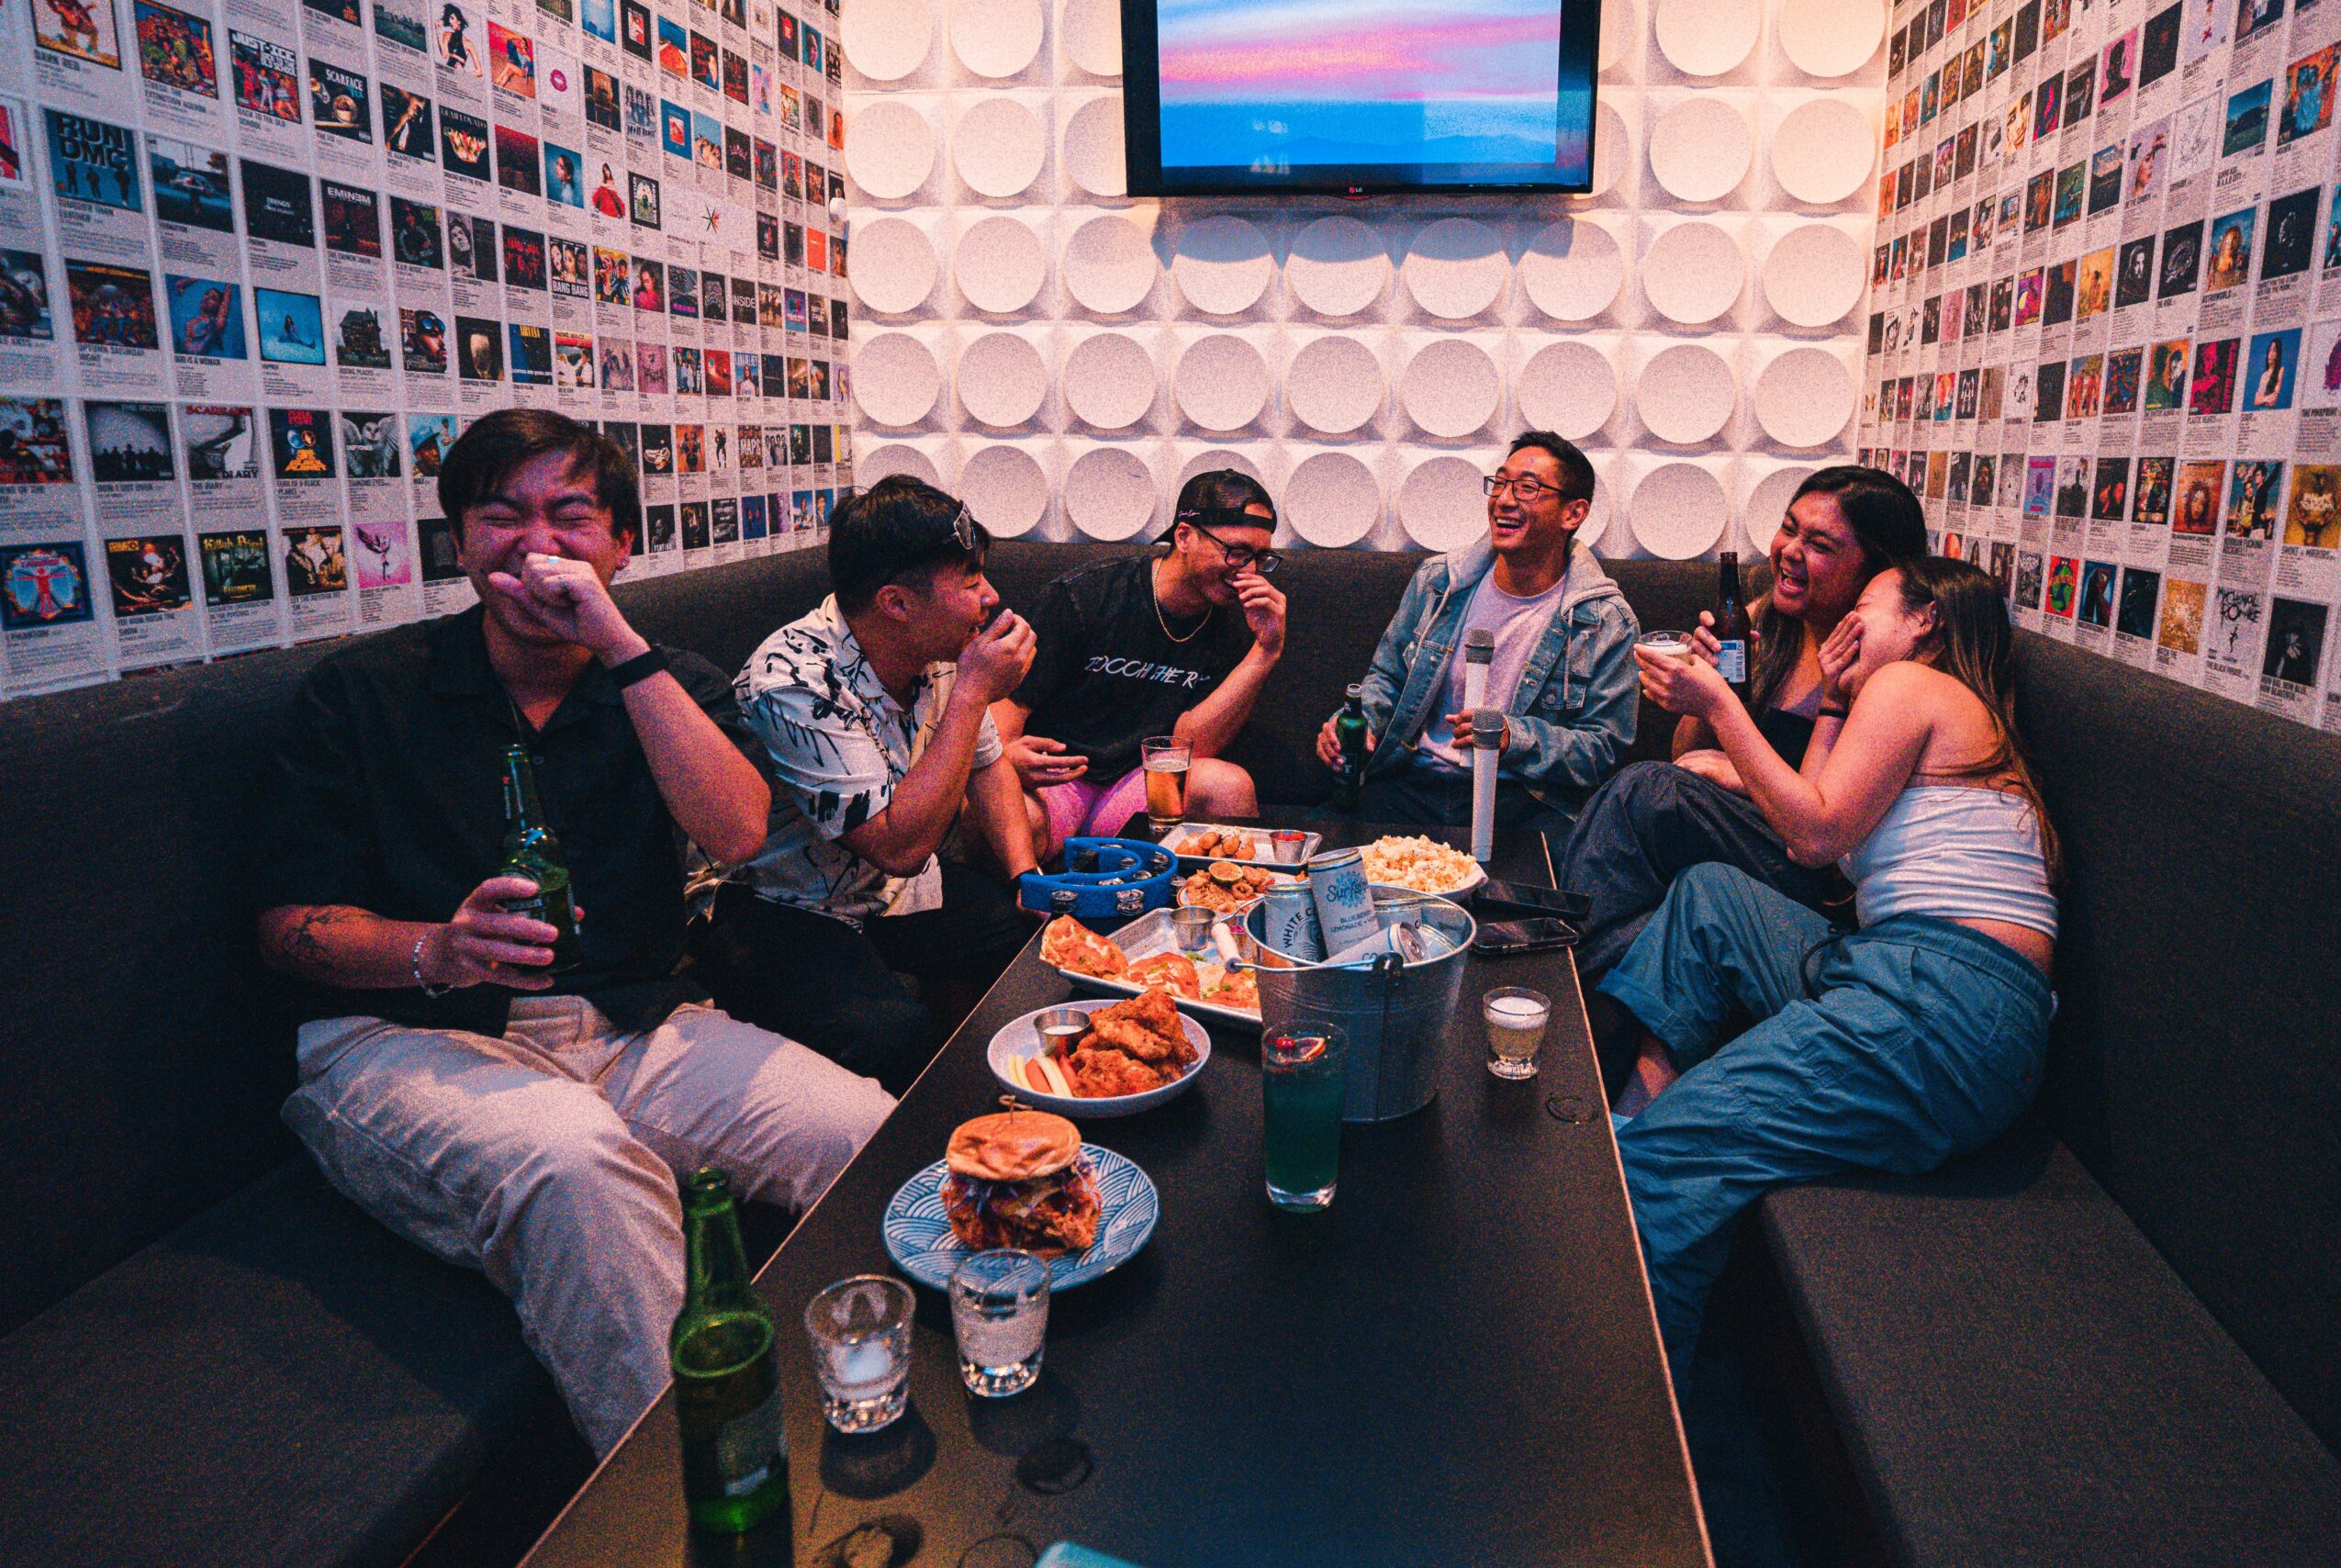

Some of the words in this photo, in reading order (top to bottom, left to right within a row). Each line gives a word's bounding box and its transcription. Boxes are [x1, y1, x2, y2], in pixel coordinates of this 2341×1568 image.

[325, 68, 364, 91] SCARFACE
[58, 113, 125, 149] RUN
[61, 138, 129, 170] DMC
[327, 186, 371, 207] EMINEM
[553, 281, 569, 295] BANG
[571, 284, 588, 297] BANG
[740, 439, 761, 454] MAPS
[1283, 912, 1305, 948] WHITE
